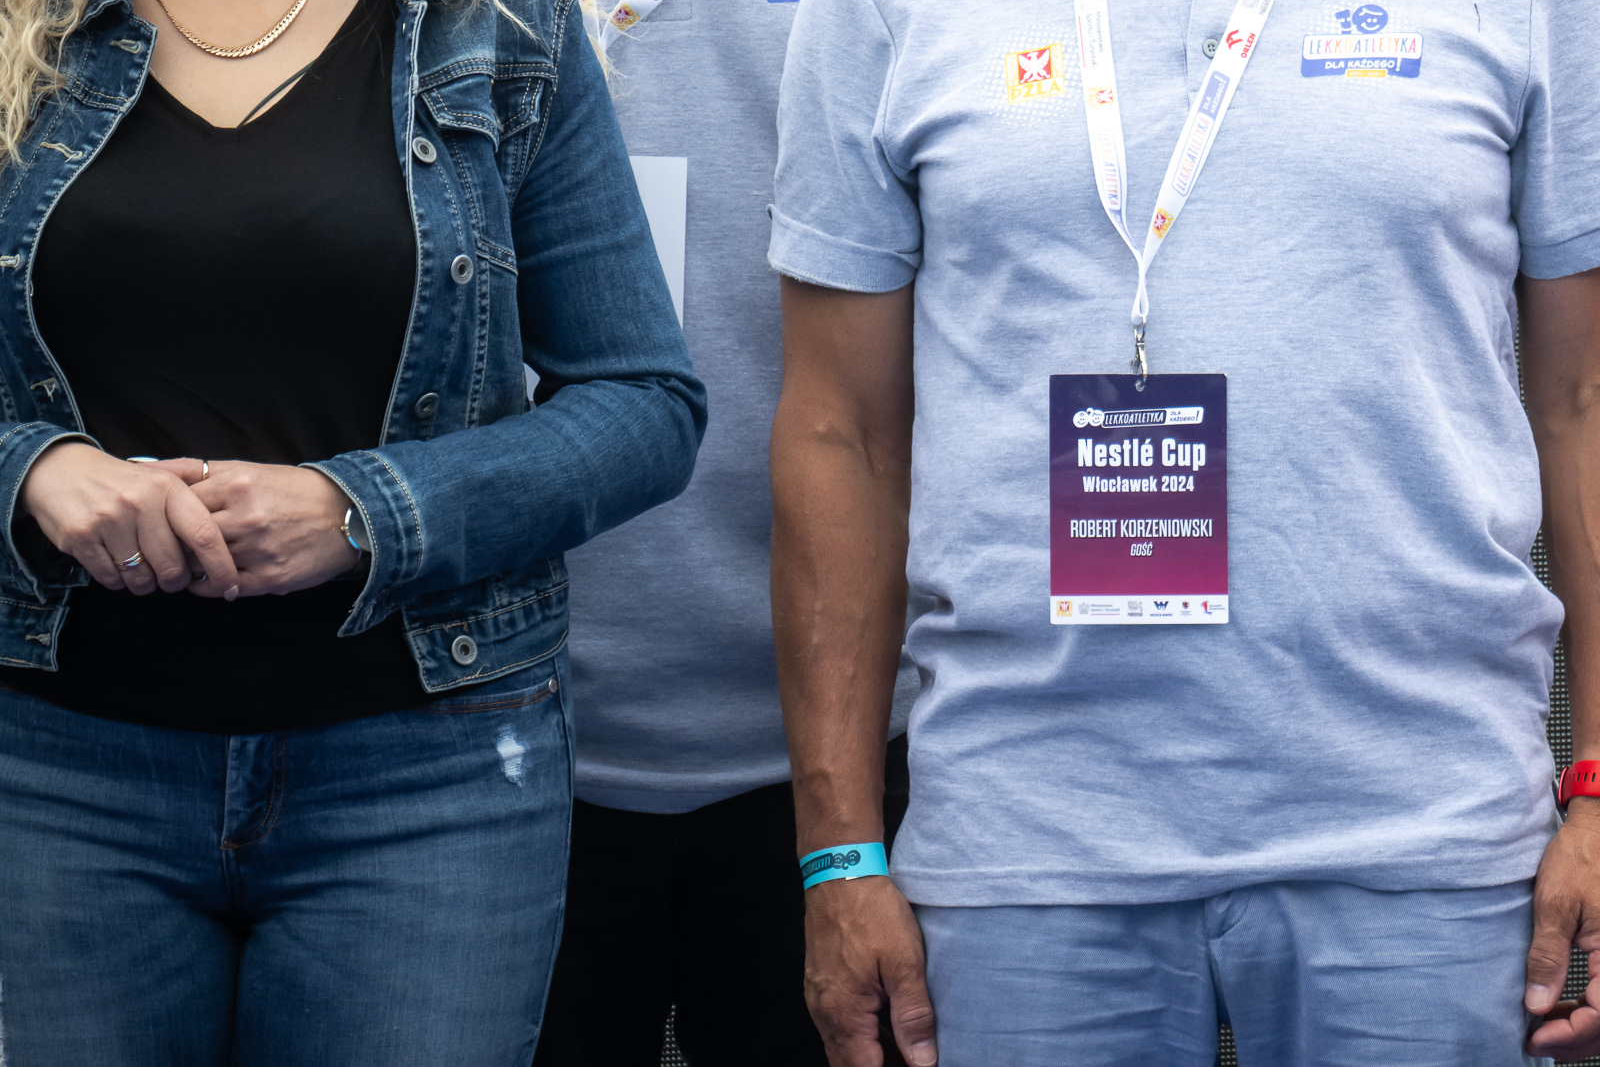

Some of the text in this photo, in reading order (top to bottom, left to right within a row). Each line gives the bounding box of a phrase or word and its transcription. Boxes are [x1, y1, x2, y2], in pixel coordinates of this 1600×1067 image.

[1240, 32, 1256, 59] ORLEN
[1309, 37, 1416, 54] LEKKOATLETYKA
[1324, 58, 1402, 72] DLA KAŻDEGO!
[1010, 80, 1061, 102] PZLA
[1202, 96, 1212, 110] DLA
[1176, 117, 1209, 191] LEKKOATLETYKA
[1105, 411, 1164, 425] LEKKOATLETYKA
[1077, 438, 1206, 471] Nestlé Cup
[1083, 475, 1194, 493] Włocławek 2024
[1070, 519, 1213, 538] ROBERT KORZENIOWSKI
[1130, 542, 1153, 556] GOŚĆ
